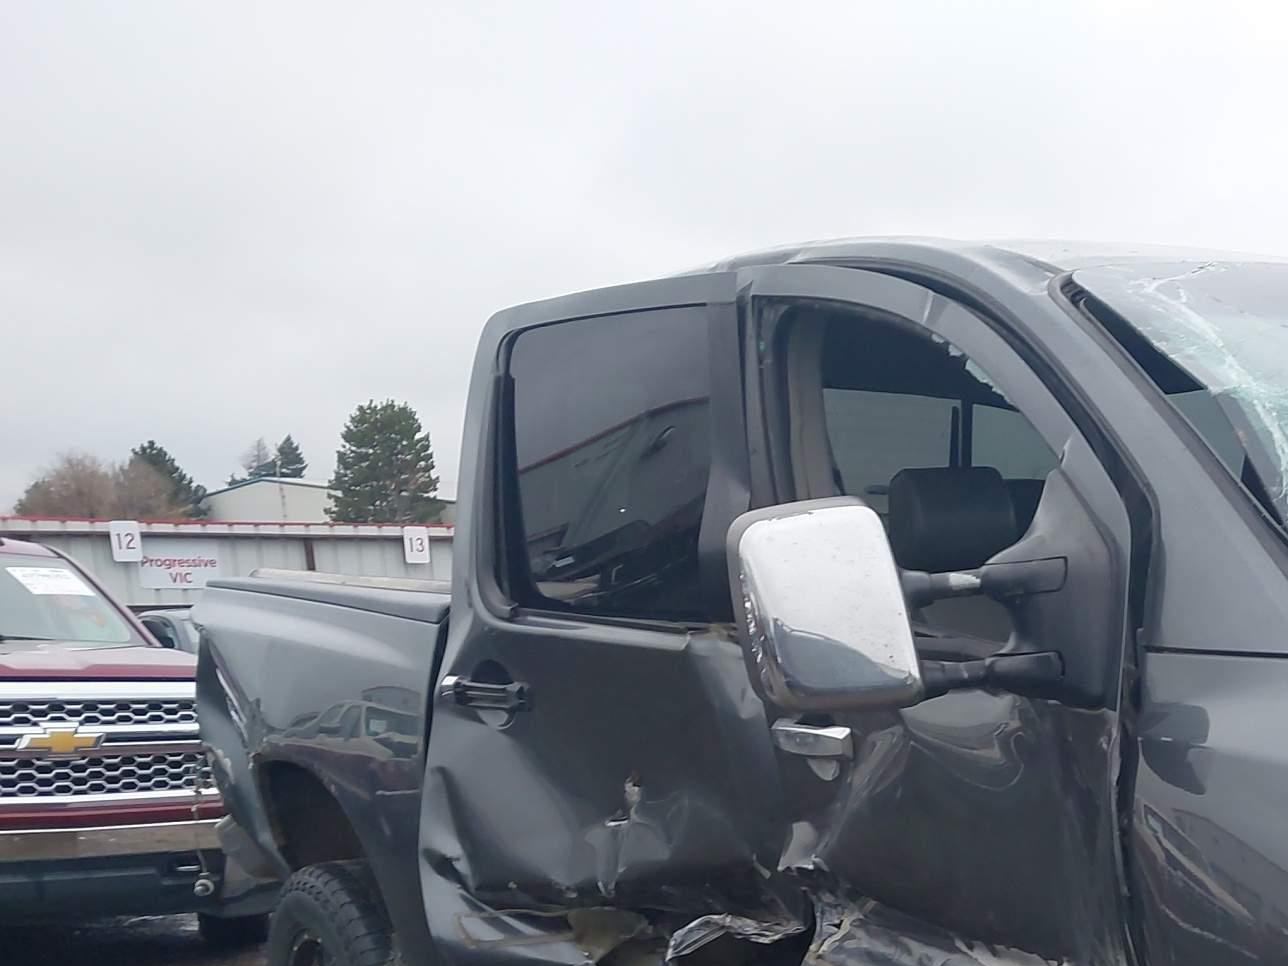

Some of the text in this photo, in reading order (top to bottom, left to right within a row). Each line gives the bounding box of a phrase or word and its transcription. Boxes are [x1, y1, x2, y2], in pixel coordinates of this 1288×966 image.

[115, 532, 137, 550] 12
[409, 537, 425, 553] 13
[141, 556, 217, 569] Progressive
[169, 572, 193, 583] VIC
